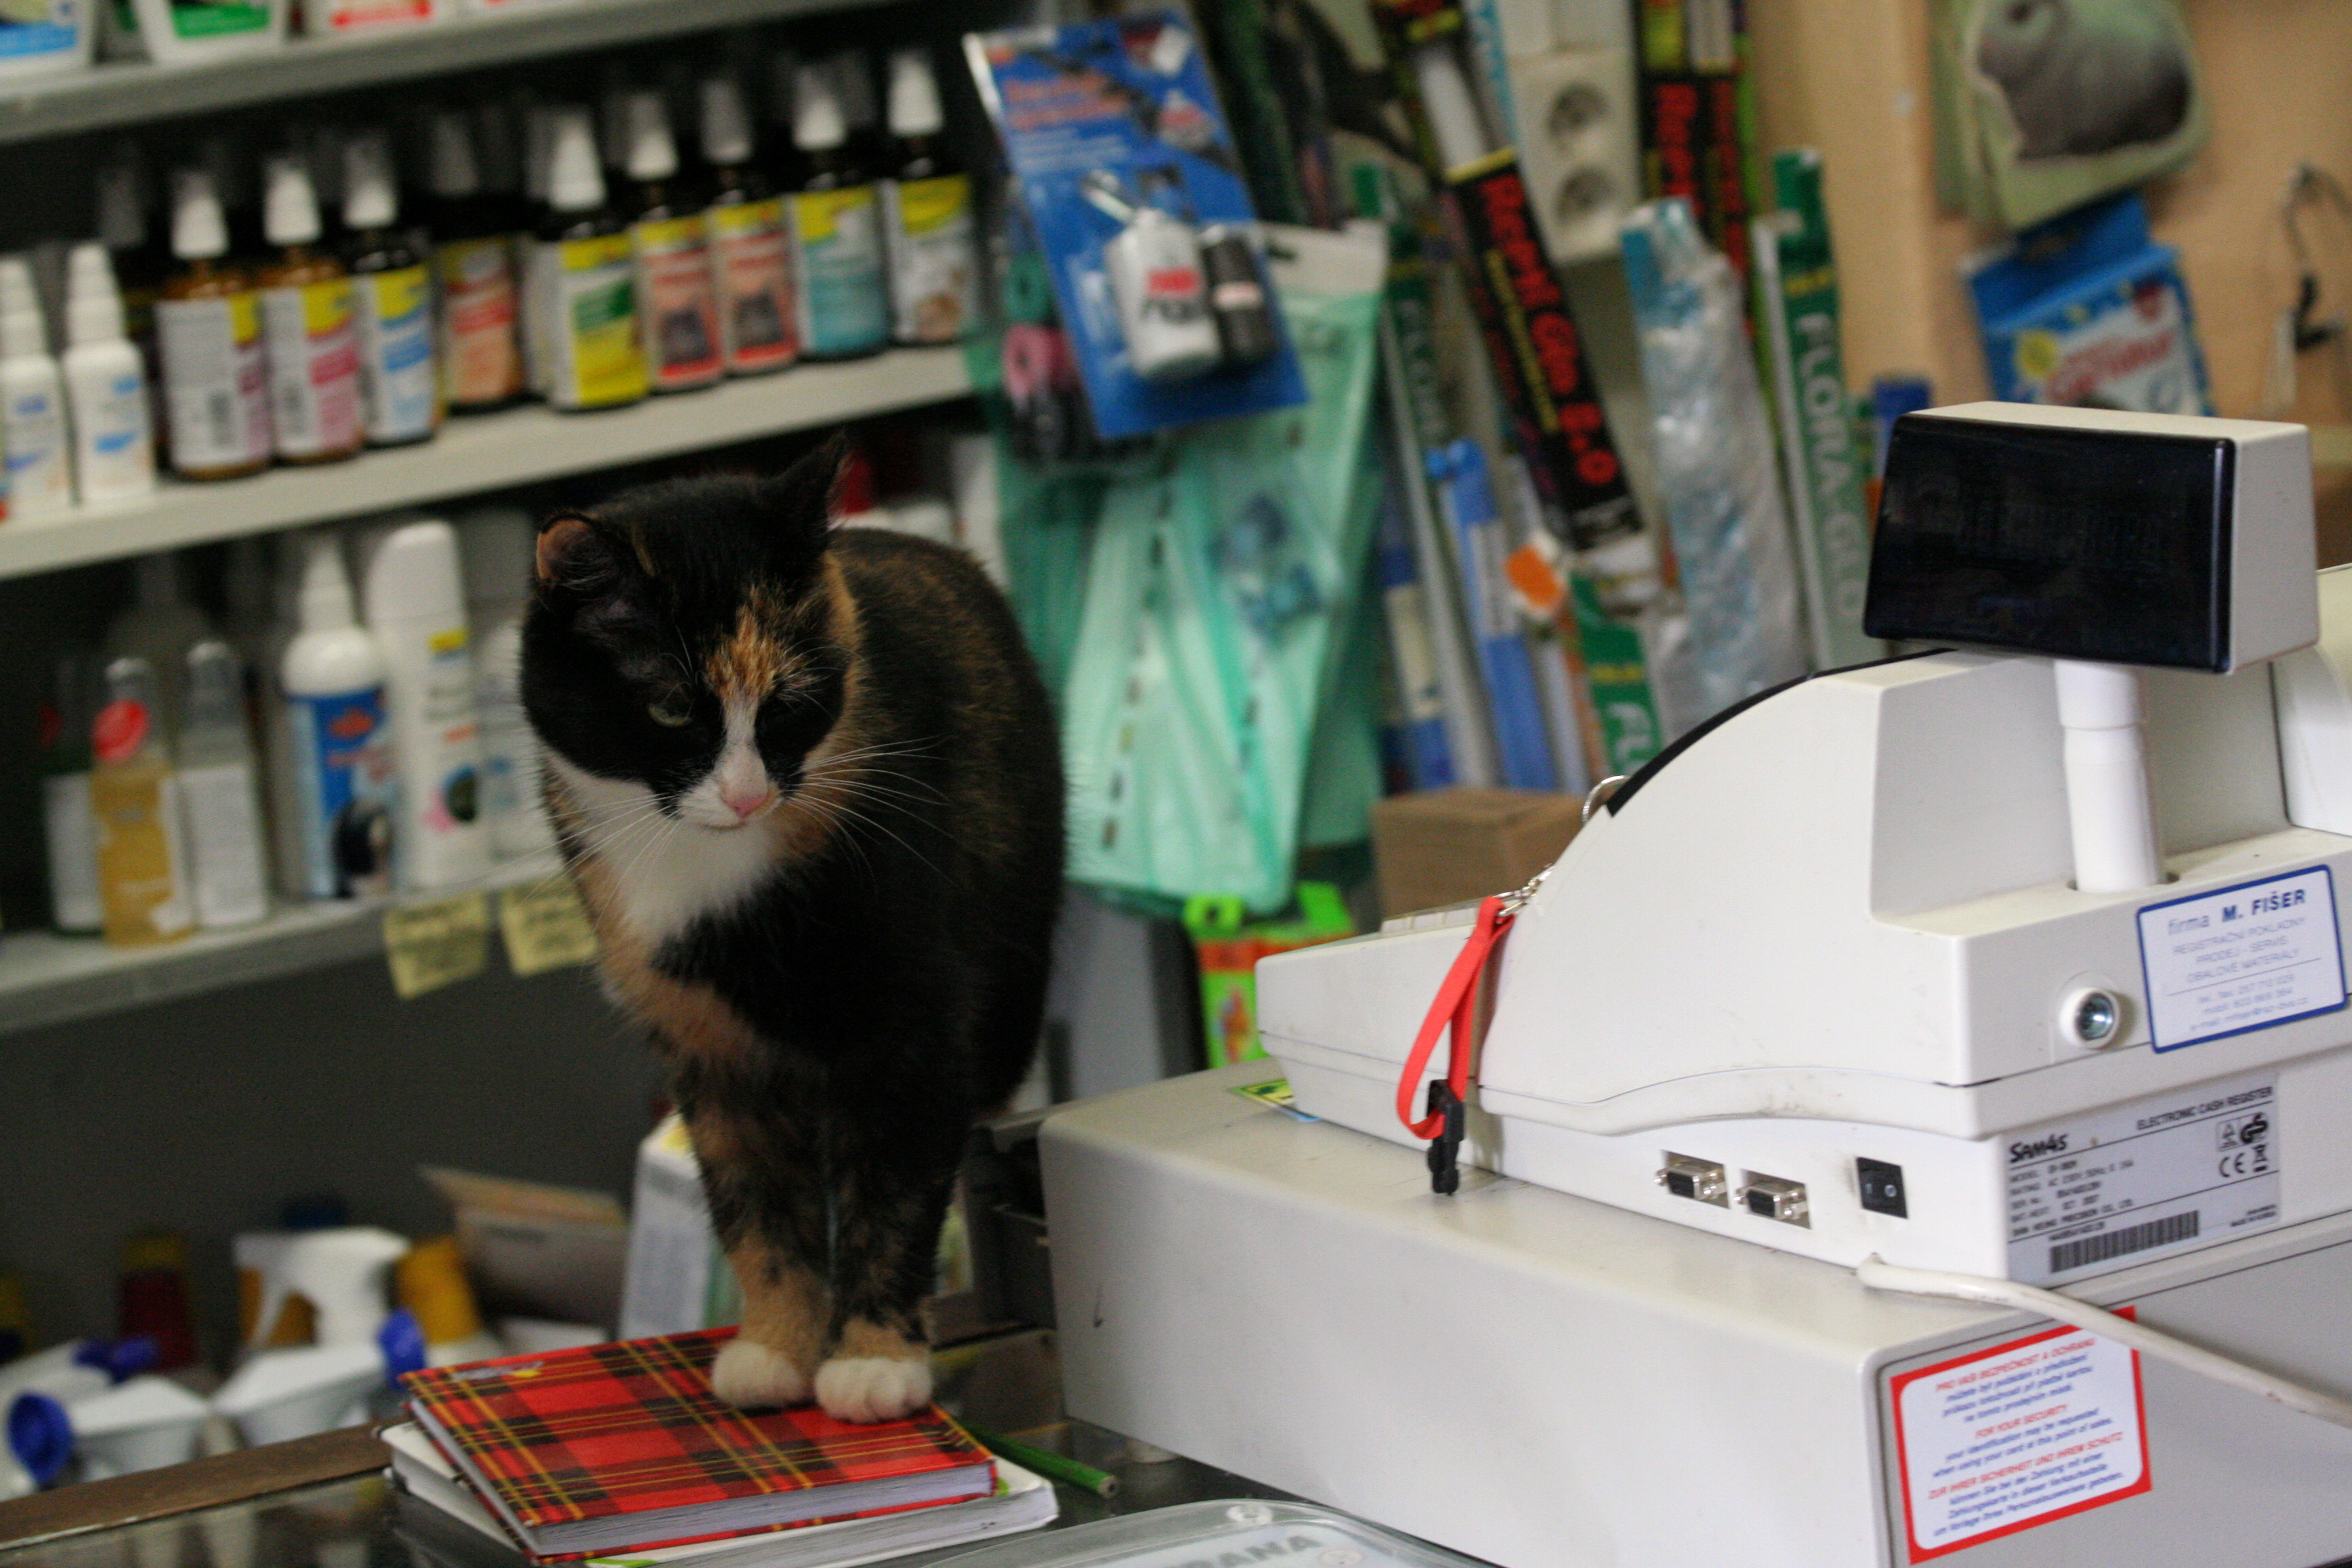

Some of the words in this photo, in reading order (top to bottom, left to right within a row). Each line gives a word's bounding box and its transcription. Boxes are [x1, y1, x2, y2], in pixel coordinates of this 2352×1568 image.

[2221, 904, 2244, 923] M.
[2252, 889, 2306, 915] FIŠER
[2137, 1106, 2196, 1130] ELECTRONIC
[2199, 1100, 2225, 1114] CASH
[2226, 1086, 2273, 1106] REGISTER
[1997, 1418, 2021, 1431] YOUR
[2023, 1404, 2067, 1424] SECURITY
